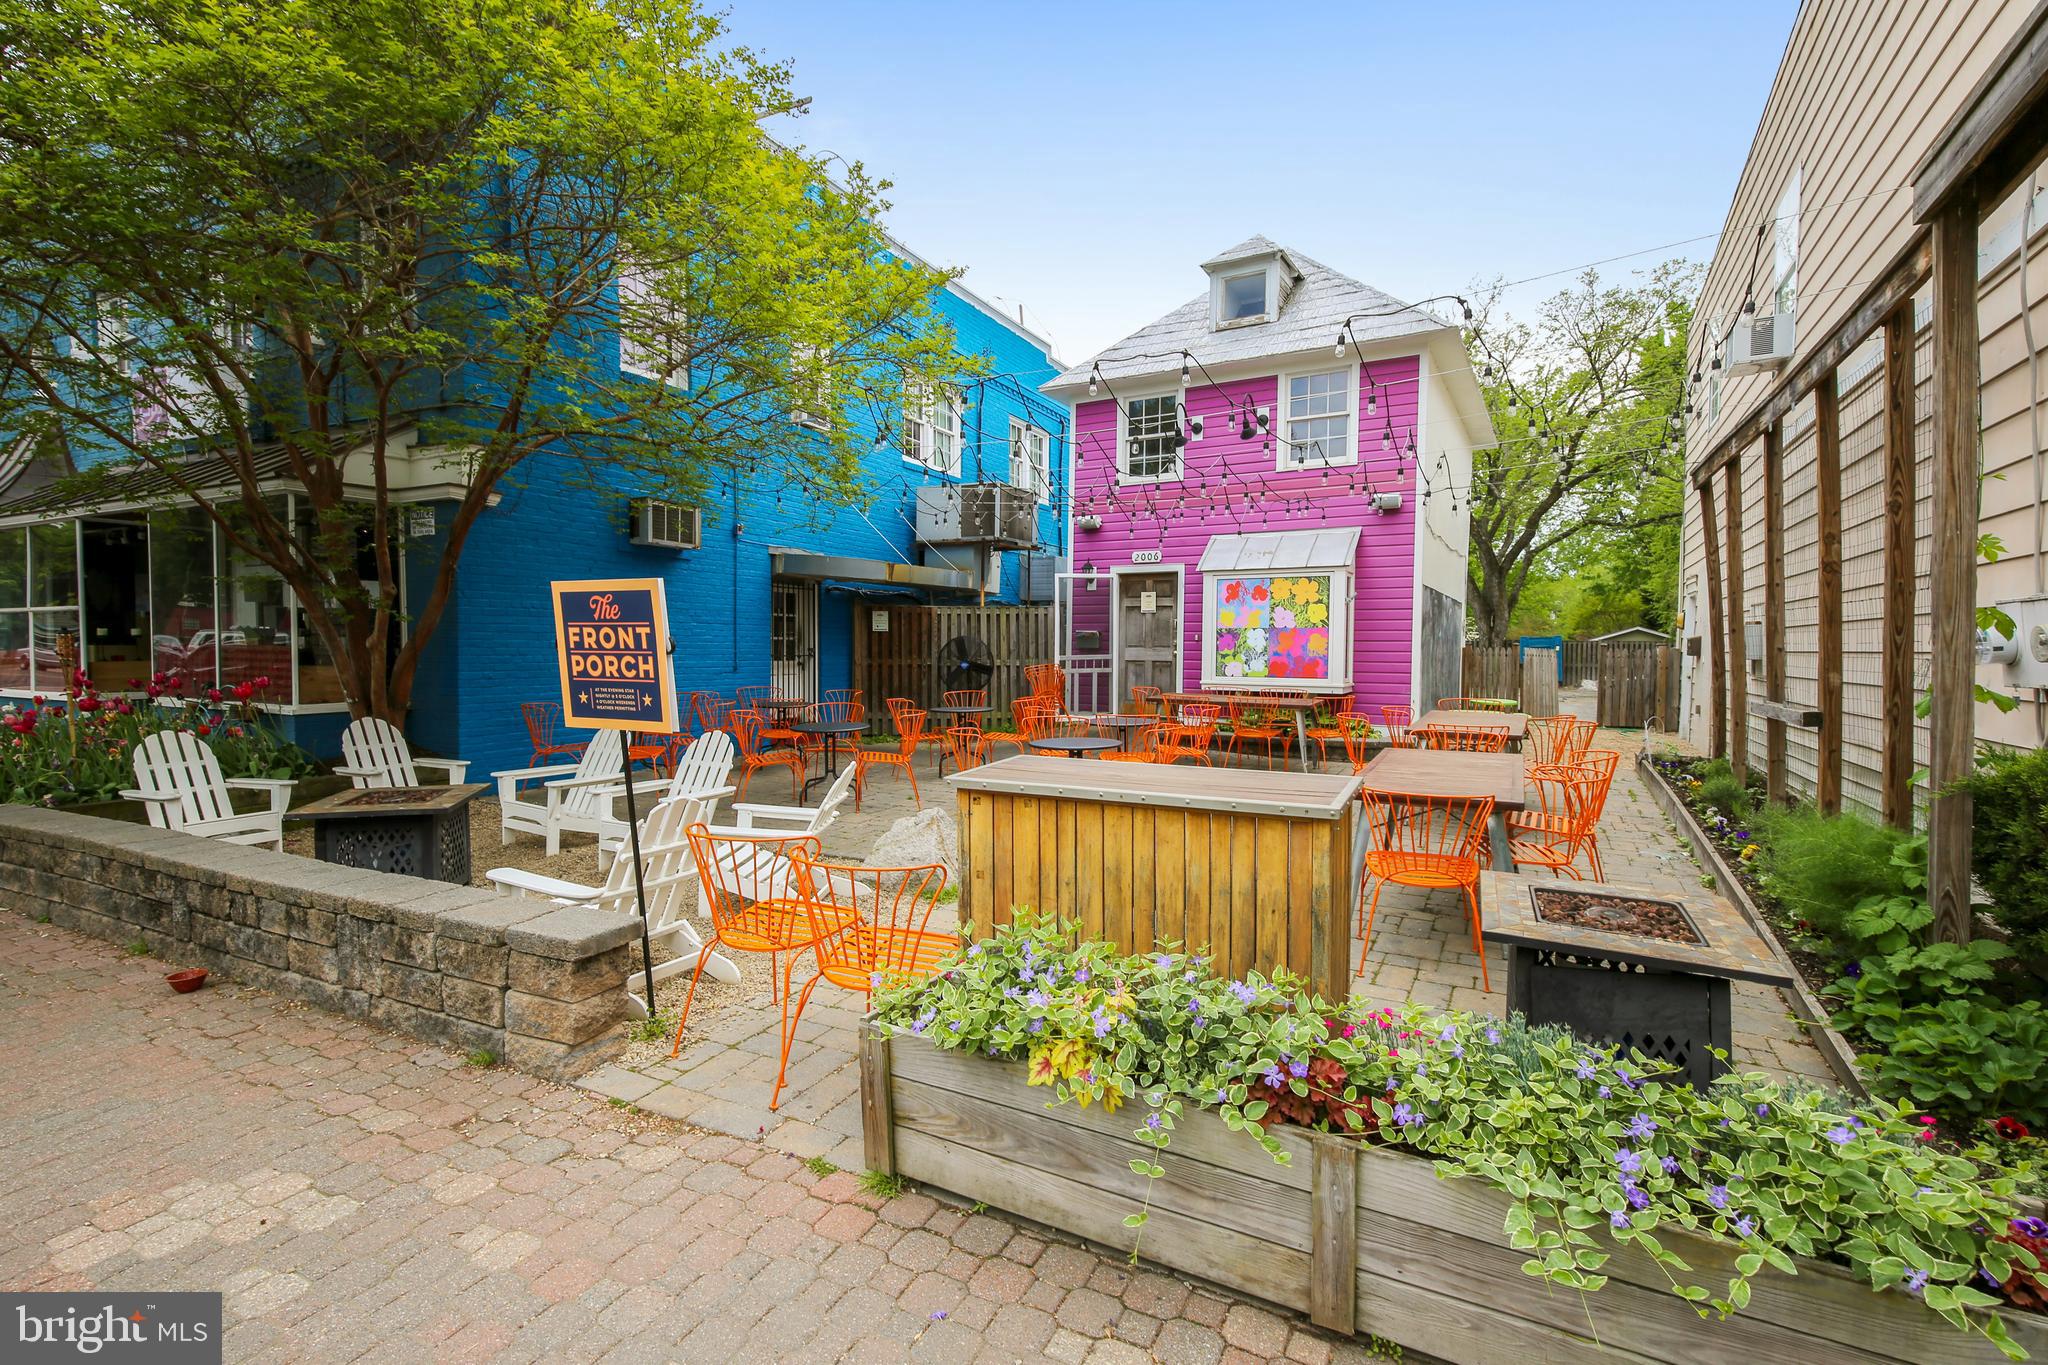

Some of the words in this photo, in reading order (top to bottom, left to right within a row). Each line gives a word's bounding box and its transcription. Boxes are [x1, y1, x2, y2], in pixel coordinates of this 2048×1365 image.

[1134, 552, 1159, 562] 2006
[589, 593, 621, 621] The
[567, 626, 651, 649] FRONT
[570, 655, 655, 678] PORCH
